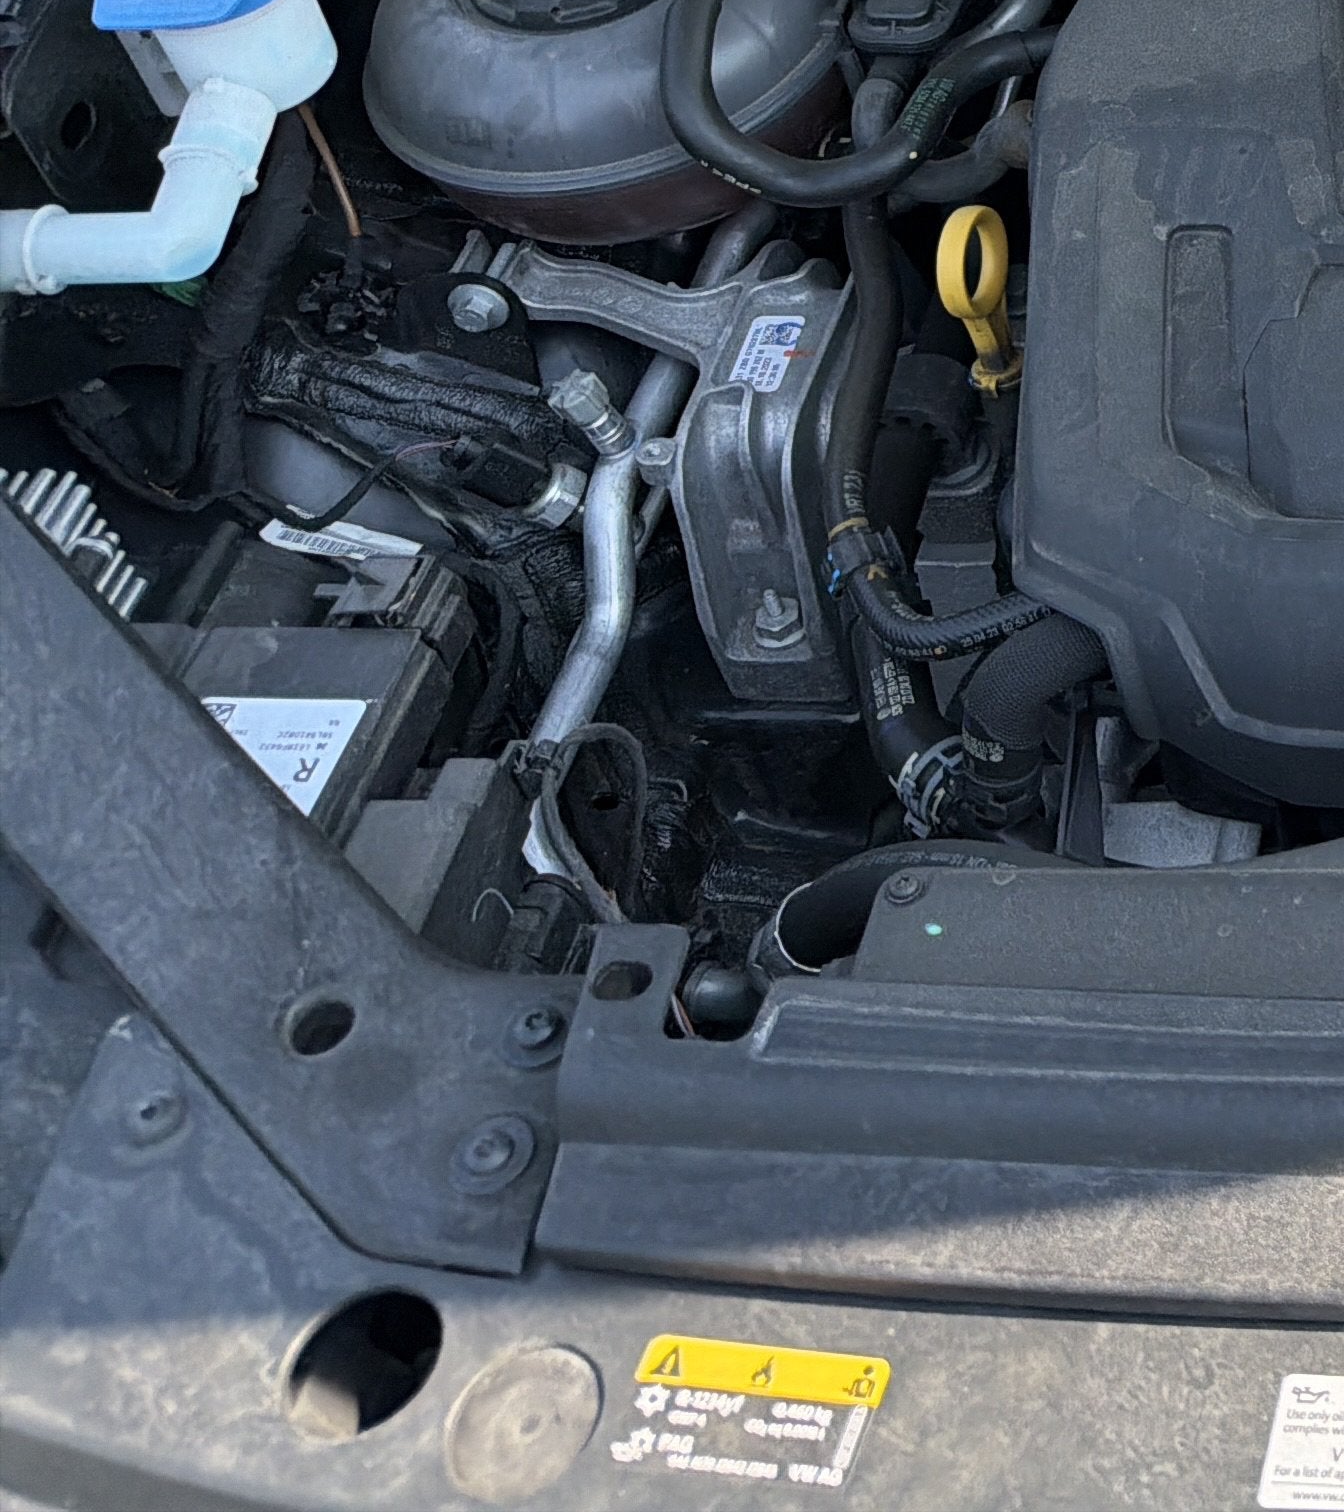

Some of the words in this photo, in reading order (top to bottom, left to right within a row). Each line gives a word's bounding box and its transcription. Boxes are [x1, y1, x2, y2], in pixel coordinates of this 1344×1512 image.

[293, 757, 320, 783] R
[1286, 1408, 1307, 1420] Use
[1308, 1410, 1329, 1423] only
[1283, 1423, 1329, 1437] complies
[1274, 1465, 1291, 1476] For
[1302, 1466, 1319, 1478] list
[1320, 1467, 1333, 1479] of
